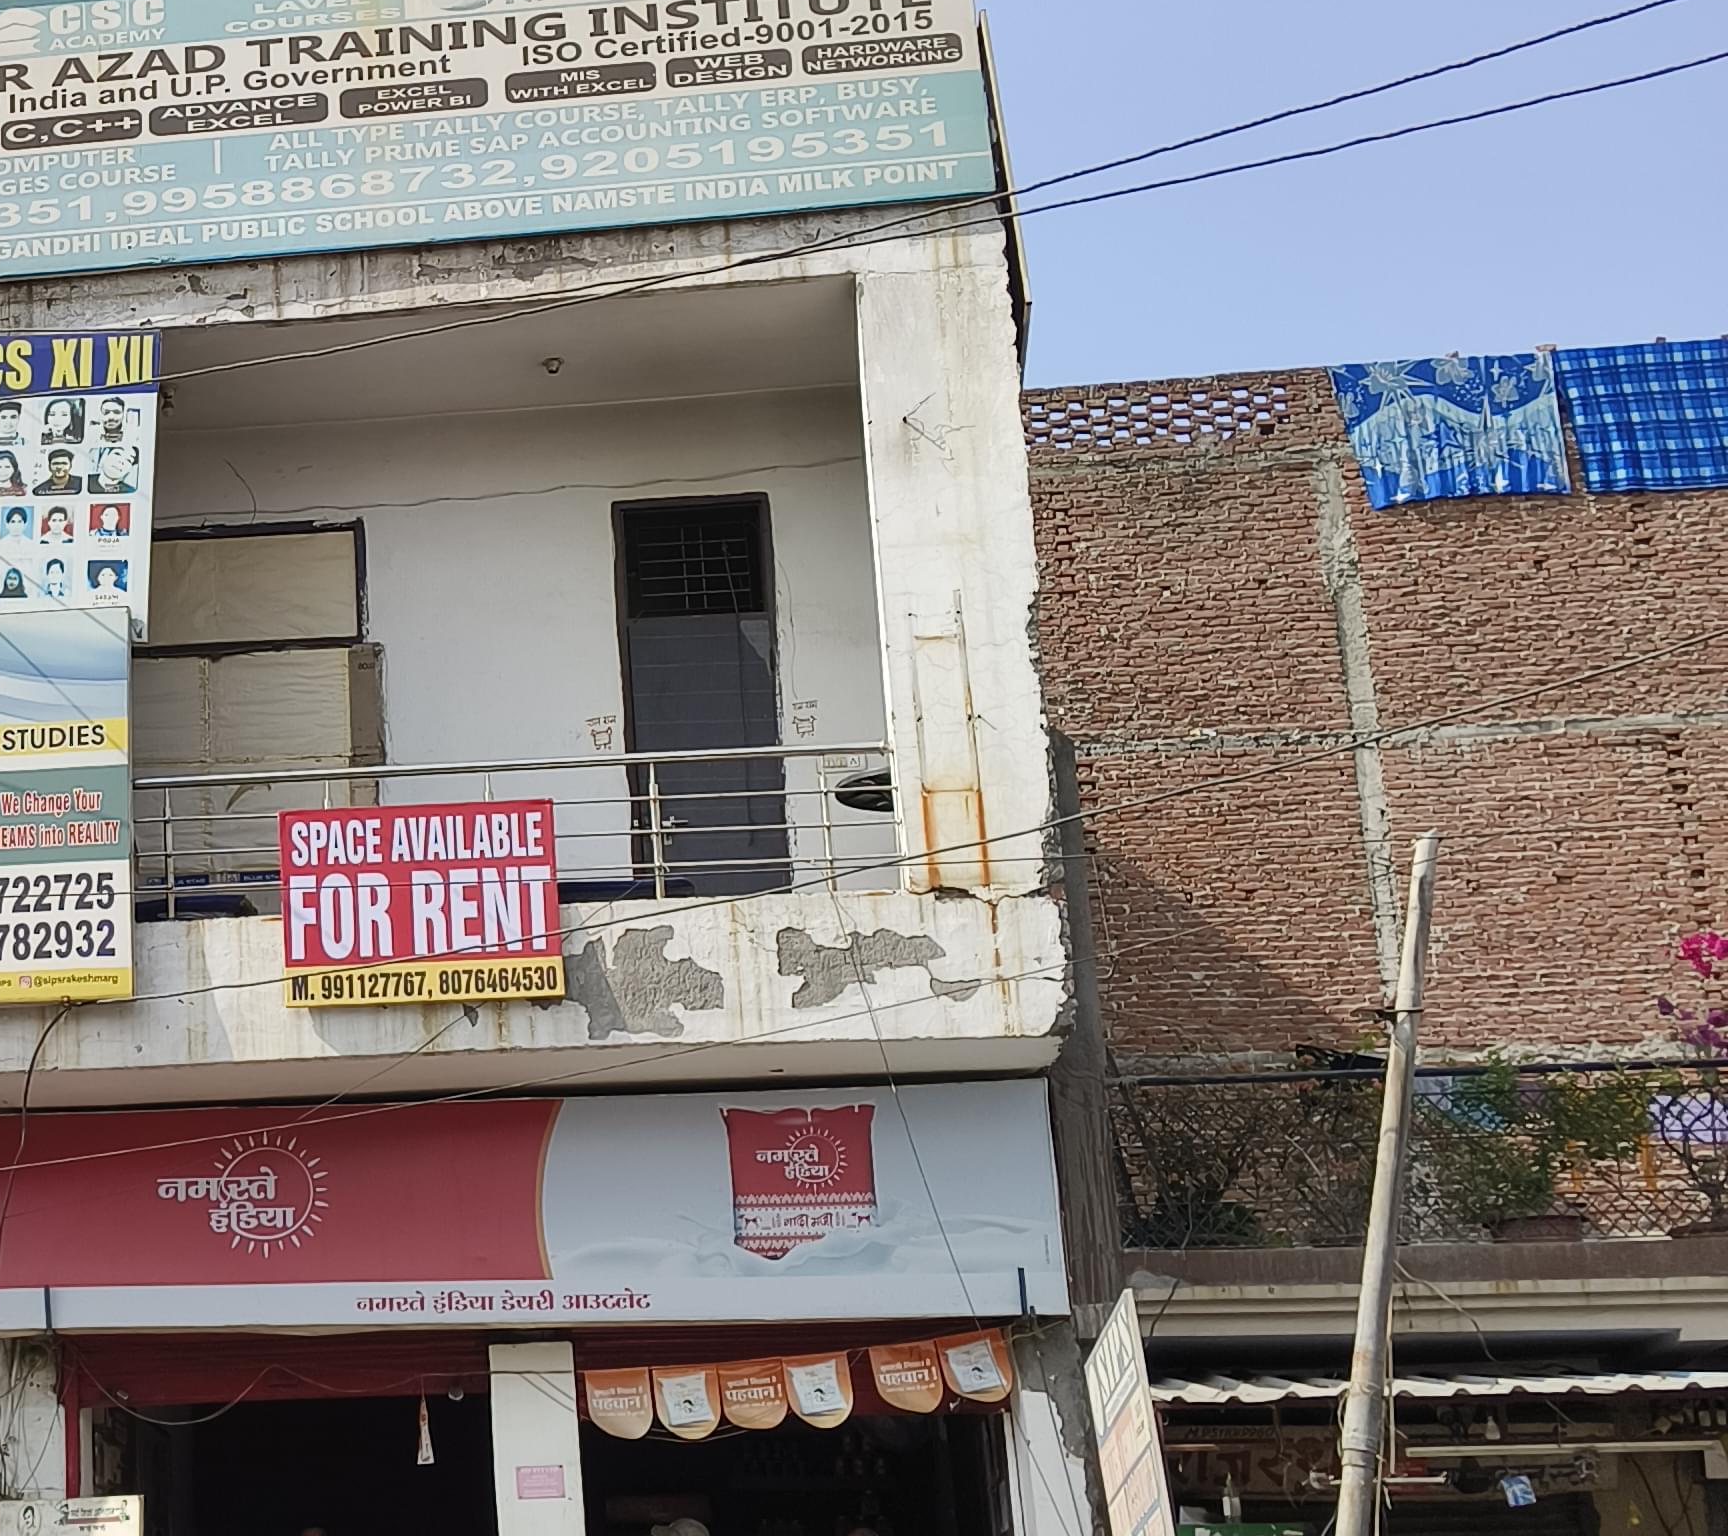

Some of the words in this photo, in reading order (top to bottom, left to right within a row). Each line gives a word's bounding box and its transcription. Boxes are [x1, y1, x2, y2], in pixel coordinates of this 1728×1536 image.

[50, 28, 166, 50] ACADEMY
[52, 46, 226, 87] AZAD
[248, 14, 565, 67] TRAINING
[10, 86, 86, 114] India
[100, 80, 157, 106] and
[170, 76, 230, 99] U.P.
[244, 54, 452, 90] Government
[522, 41, 582, 67] ISO
[594, 9, 934, 60] Certified-9001-2015
[51, 339, 92, 389] XI
[106, 335, 154, 384] XII
[2, 724, 104, 751] STUDIES
[0, 792, 19, 814] We
[24, 791, 69, 816] Change
[74, 789, 102, 812] Your
[40, 825, 64, 846] into
[68, 821, 119, 844] REALITY
[291, 818, 383, 866] SPACE
[391, 812, 544, 862] AVAILABLE
[289, 872, 393, 960] FOR
[411, 865, 551, 956] RENT
[292, 977, 315, 1001] M.
[322, 971, 433, 999] 991127767,
[439, 966, 557, 995] 8076464530
